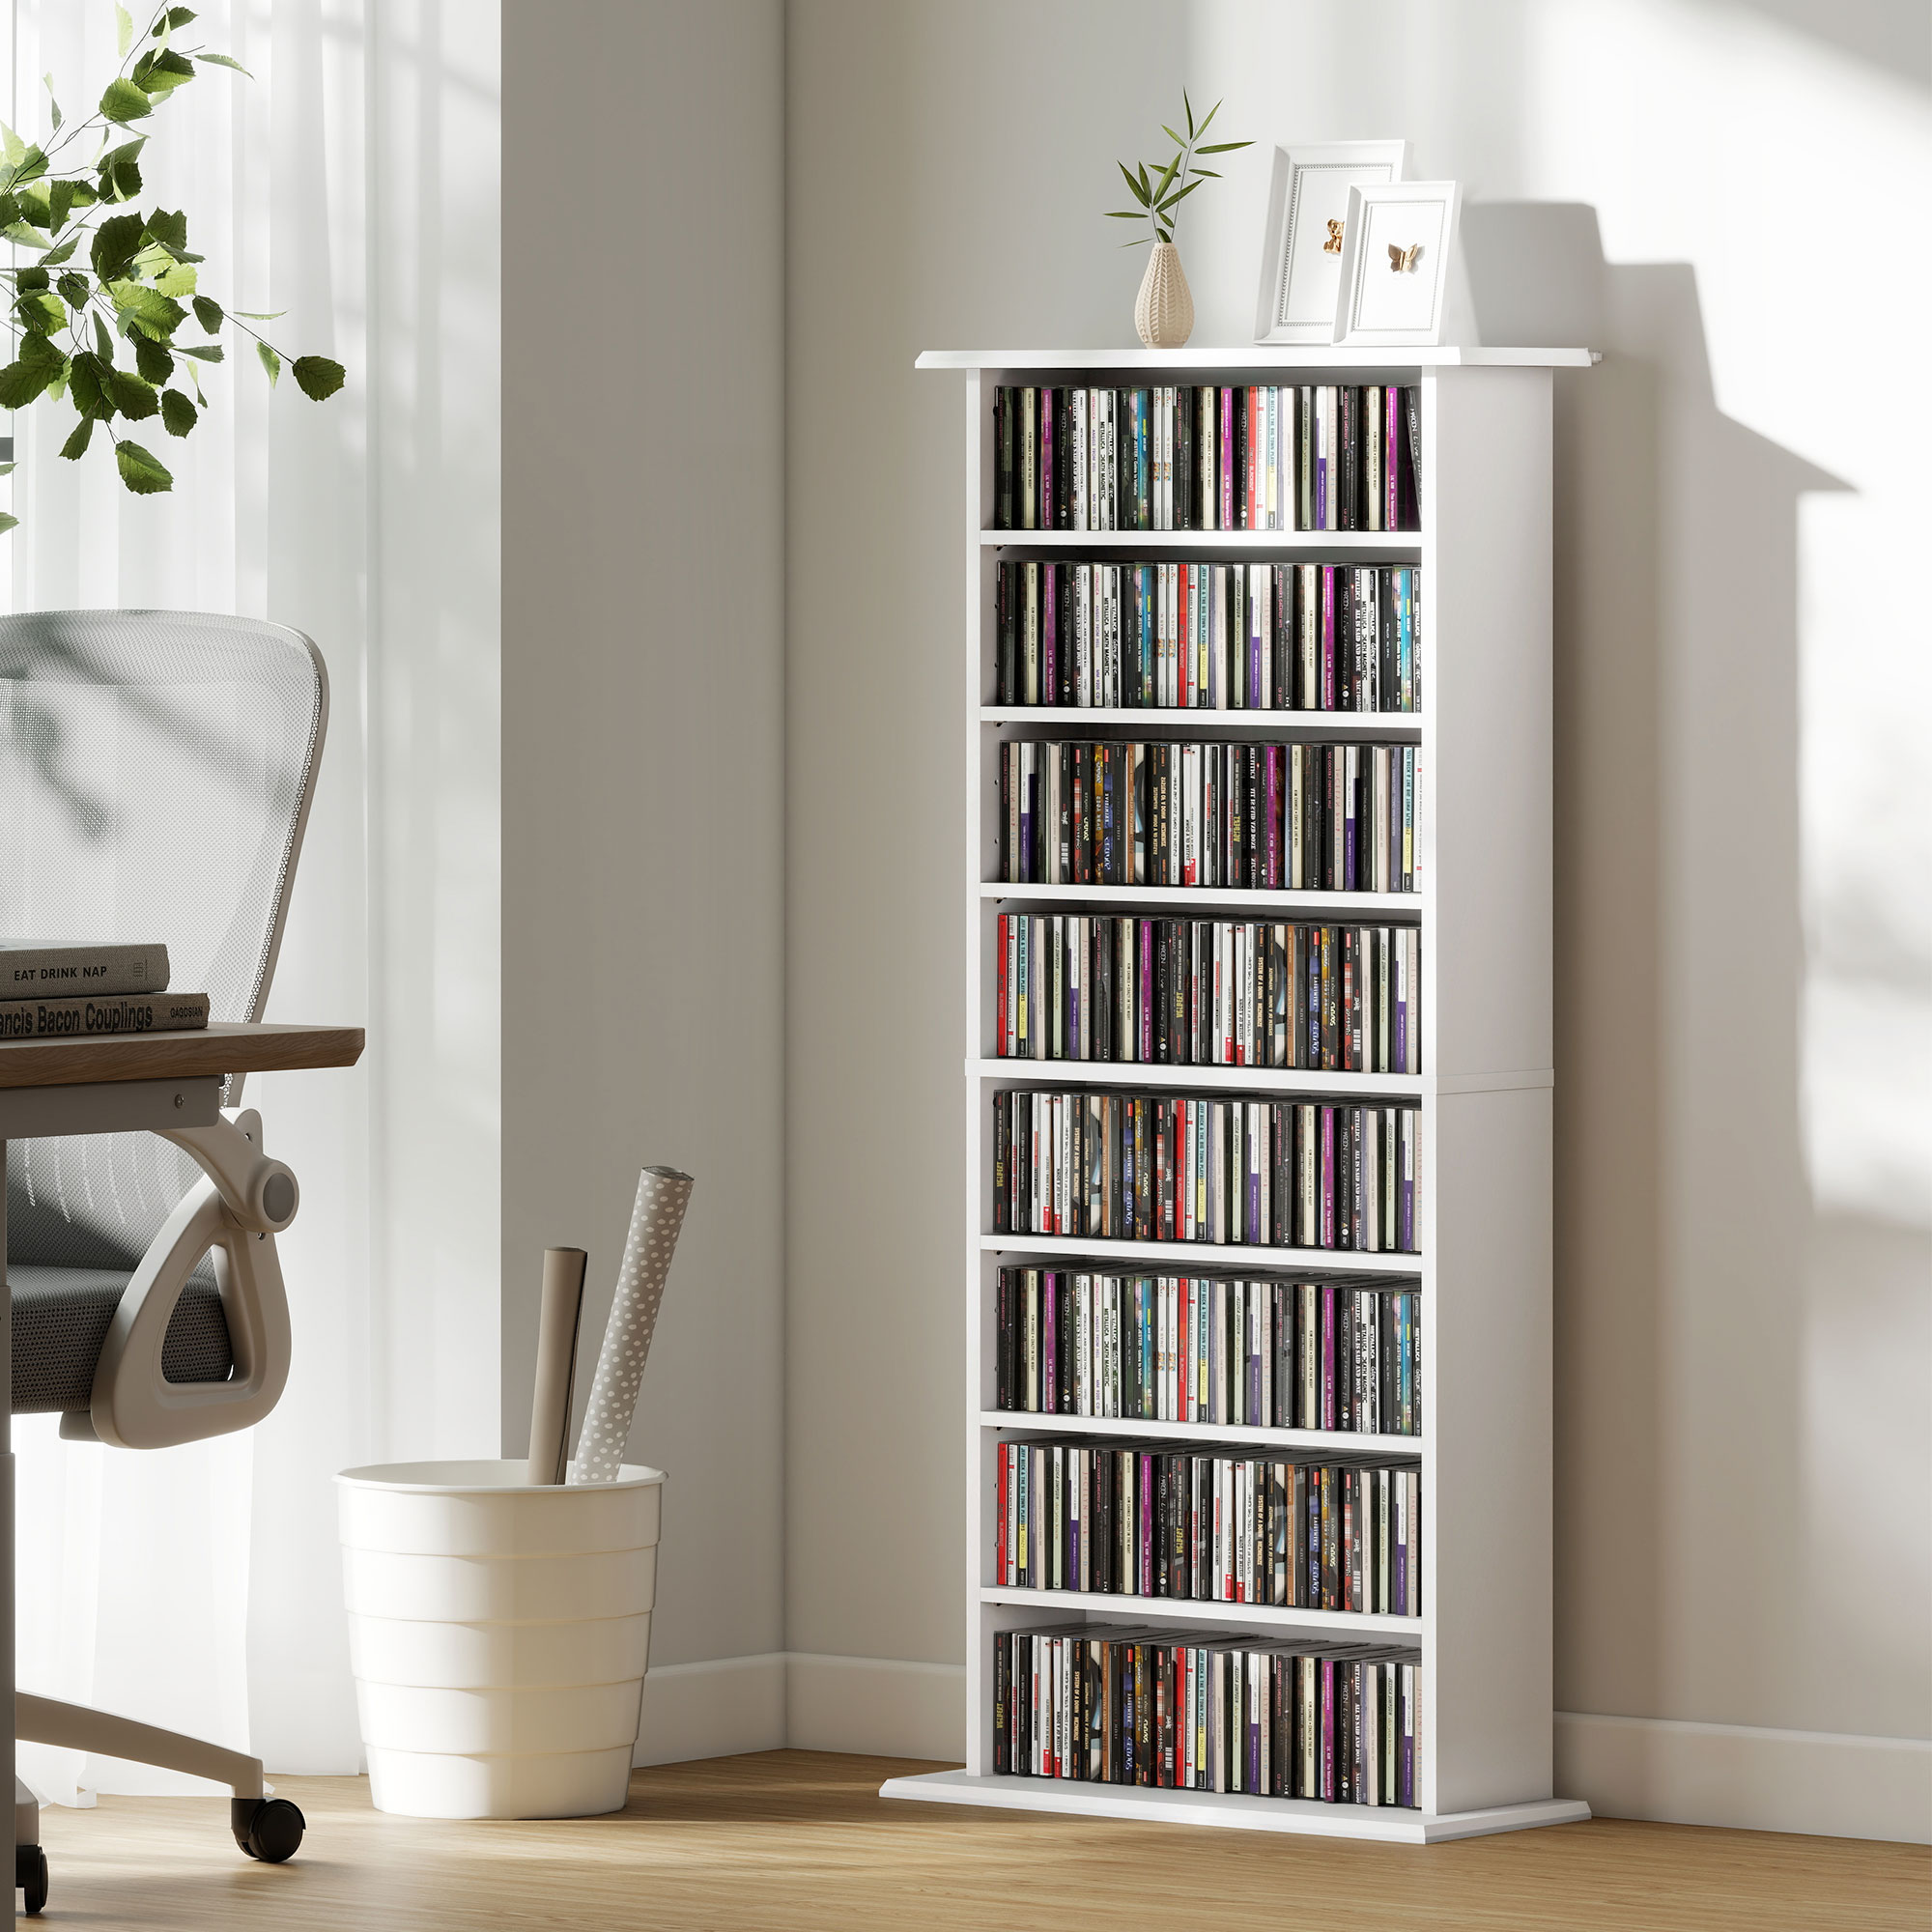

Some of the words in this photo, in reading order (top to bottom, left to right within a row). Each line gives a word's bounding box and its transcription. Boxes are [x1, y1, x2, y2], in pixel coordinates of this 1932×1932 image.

[14, 970, 36, 980] EAT
[41, 967, 77, 980] DRINK
[83, 966, 107, 978] NAP
[38, 1006, 79, 1033] Bacon
[86, 1002, 153, 1032] Couplings
